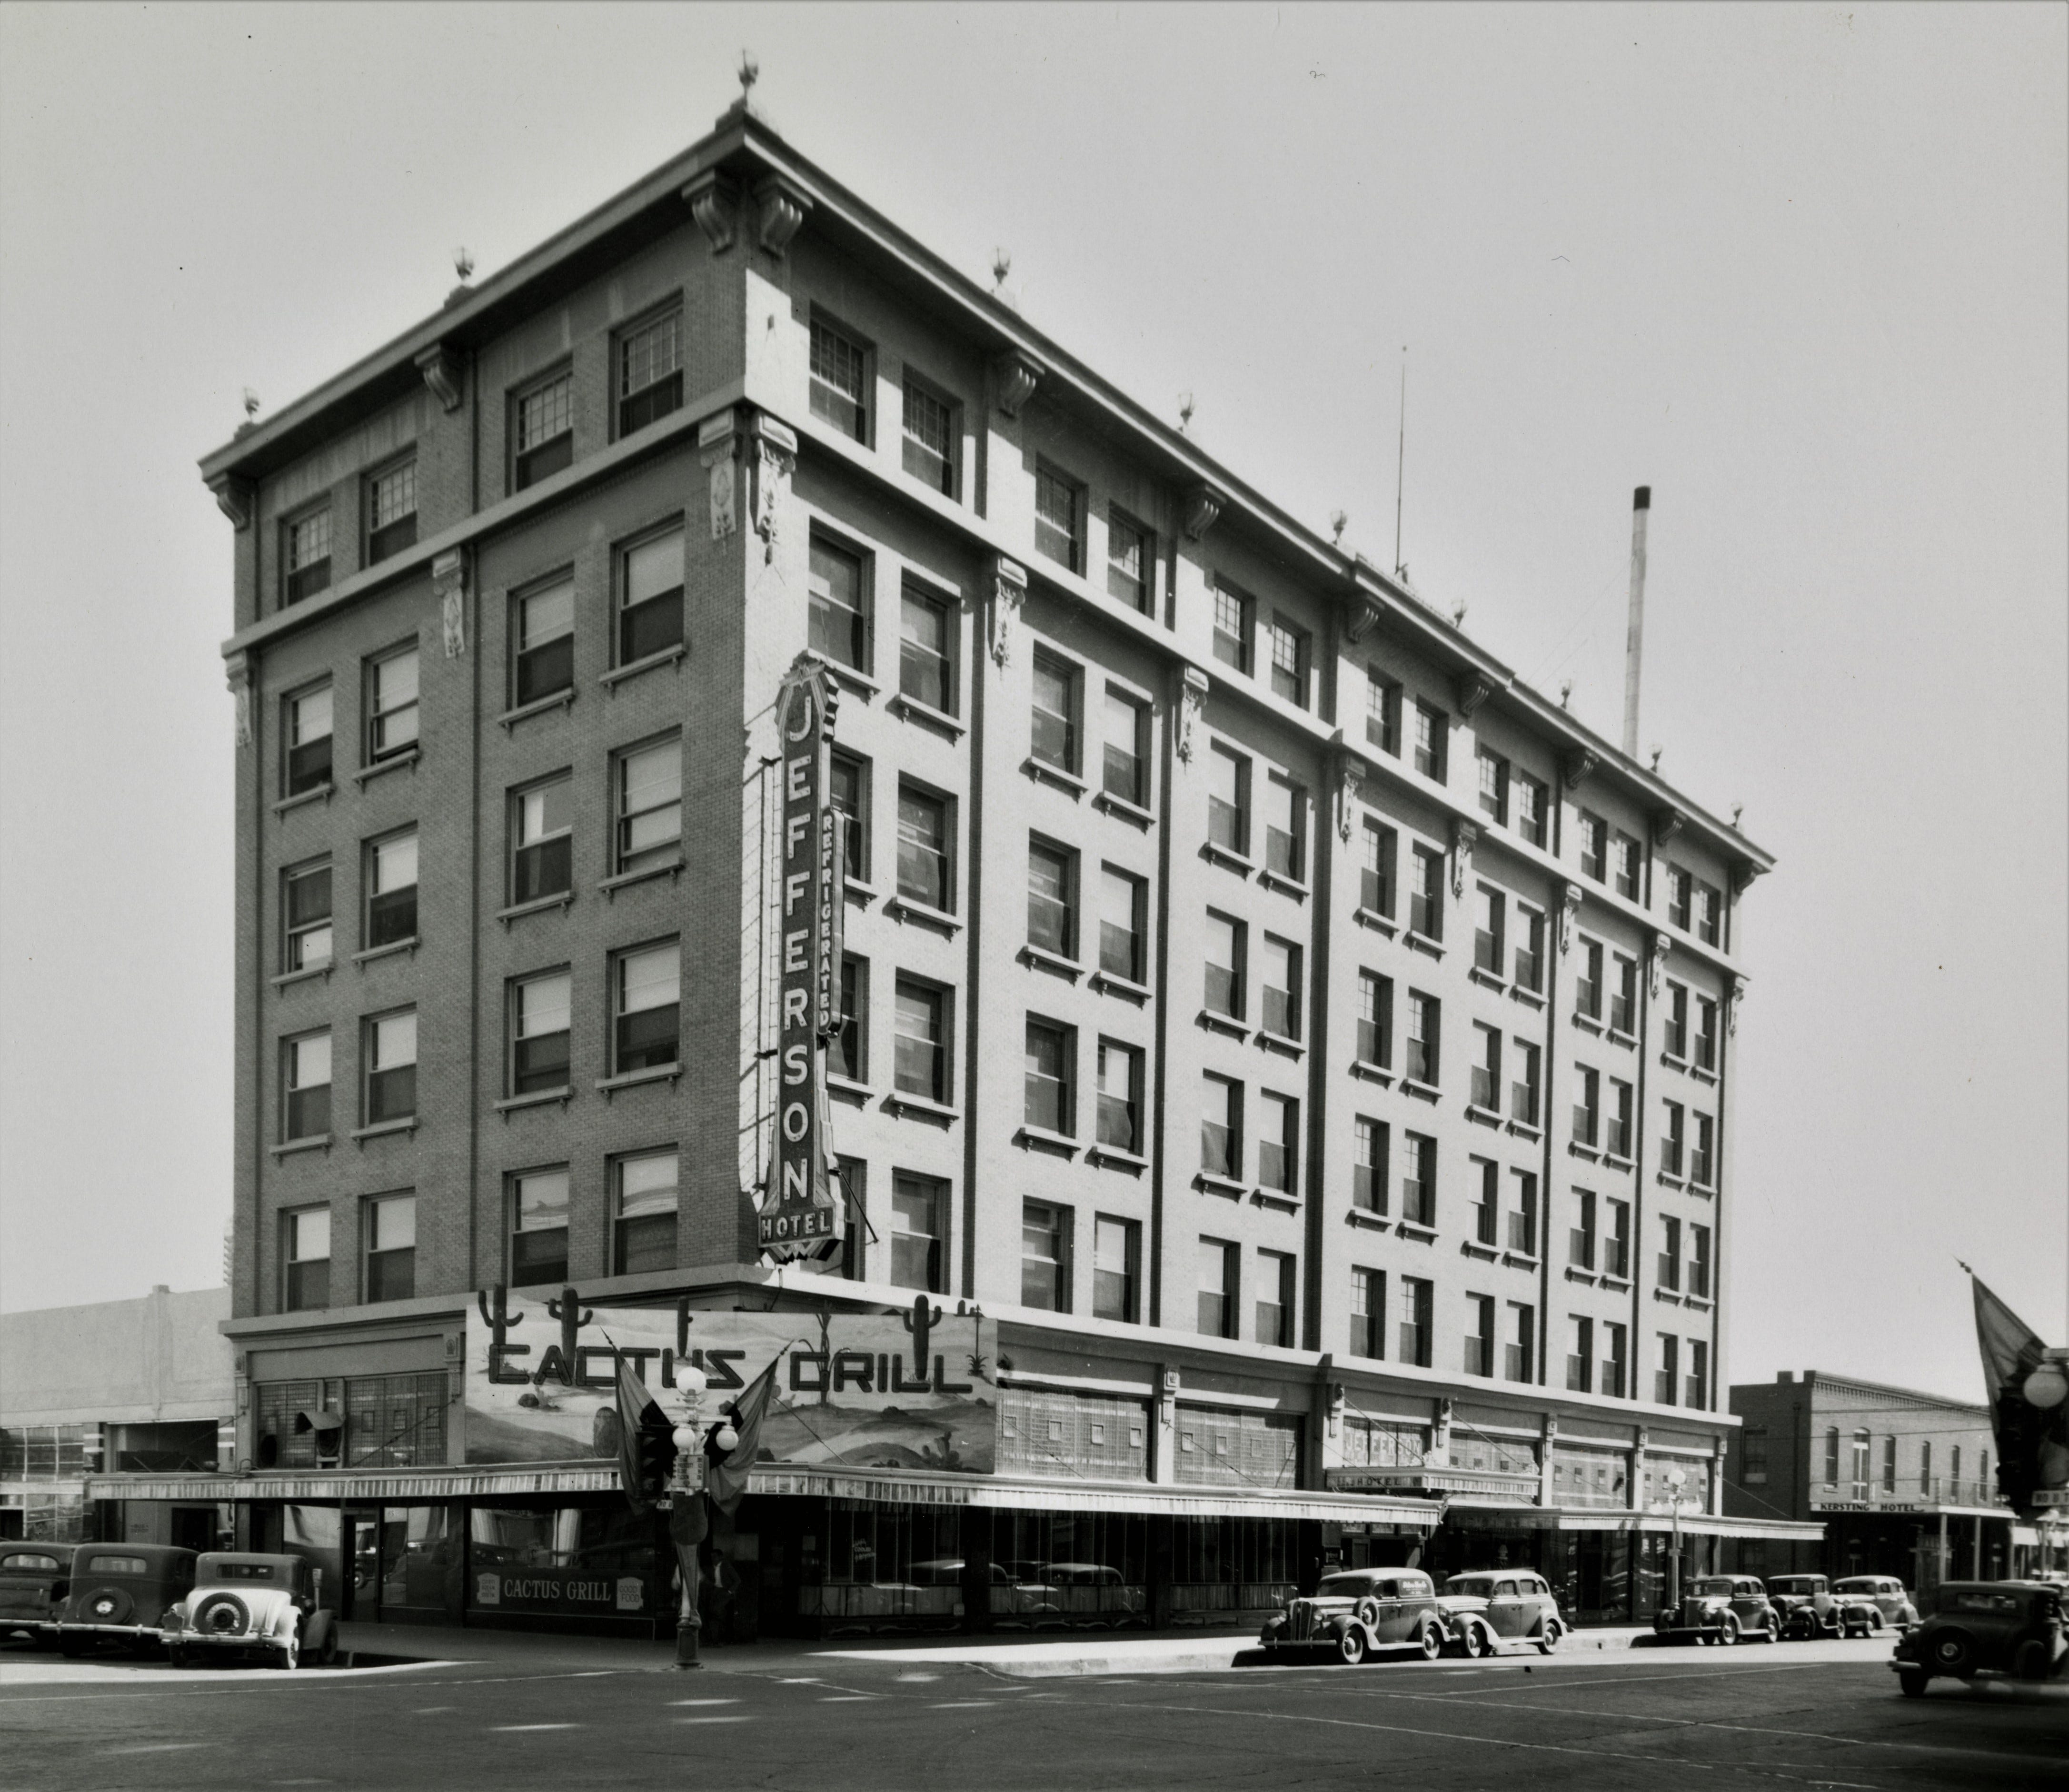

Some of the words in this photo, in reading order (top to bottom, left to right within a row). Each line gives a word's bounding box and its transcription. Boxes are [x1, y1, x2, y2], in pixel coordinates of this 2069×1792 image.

[819, 815, 833, 1027] REFRIGERATED
[784, 696, 811, 1200] JEFFERSON
[762, 1212, 830, 1238] HOTEL
[488, 1344, 746, 1389] CACTUS
[790, 1351, 973, 1393] GRILL
[1345, 1432, 1422, 1456] JEFFERSON
[1357, 1477, 1401, 1486] HOTEL
[1820, 1503, 1870, 1511] KERSTING
[1880, 1504, 1923, 1513] HOTEL
[504, 1579, 560, 1599] CACTUS
[566, 1581, 611, 1601] GRILL
[621, 1593, 640, 1603] FOOD
